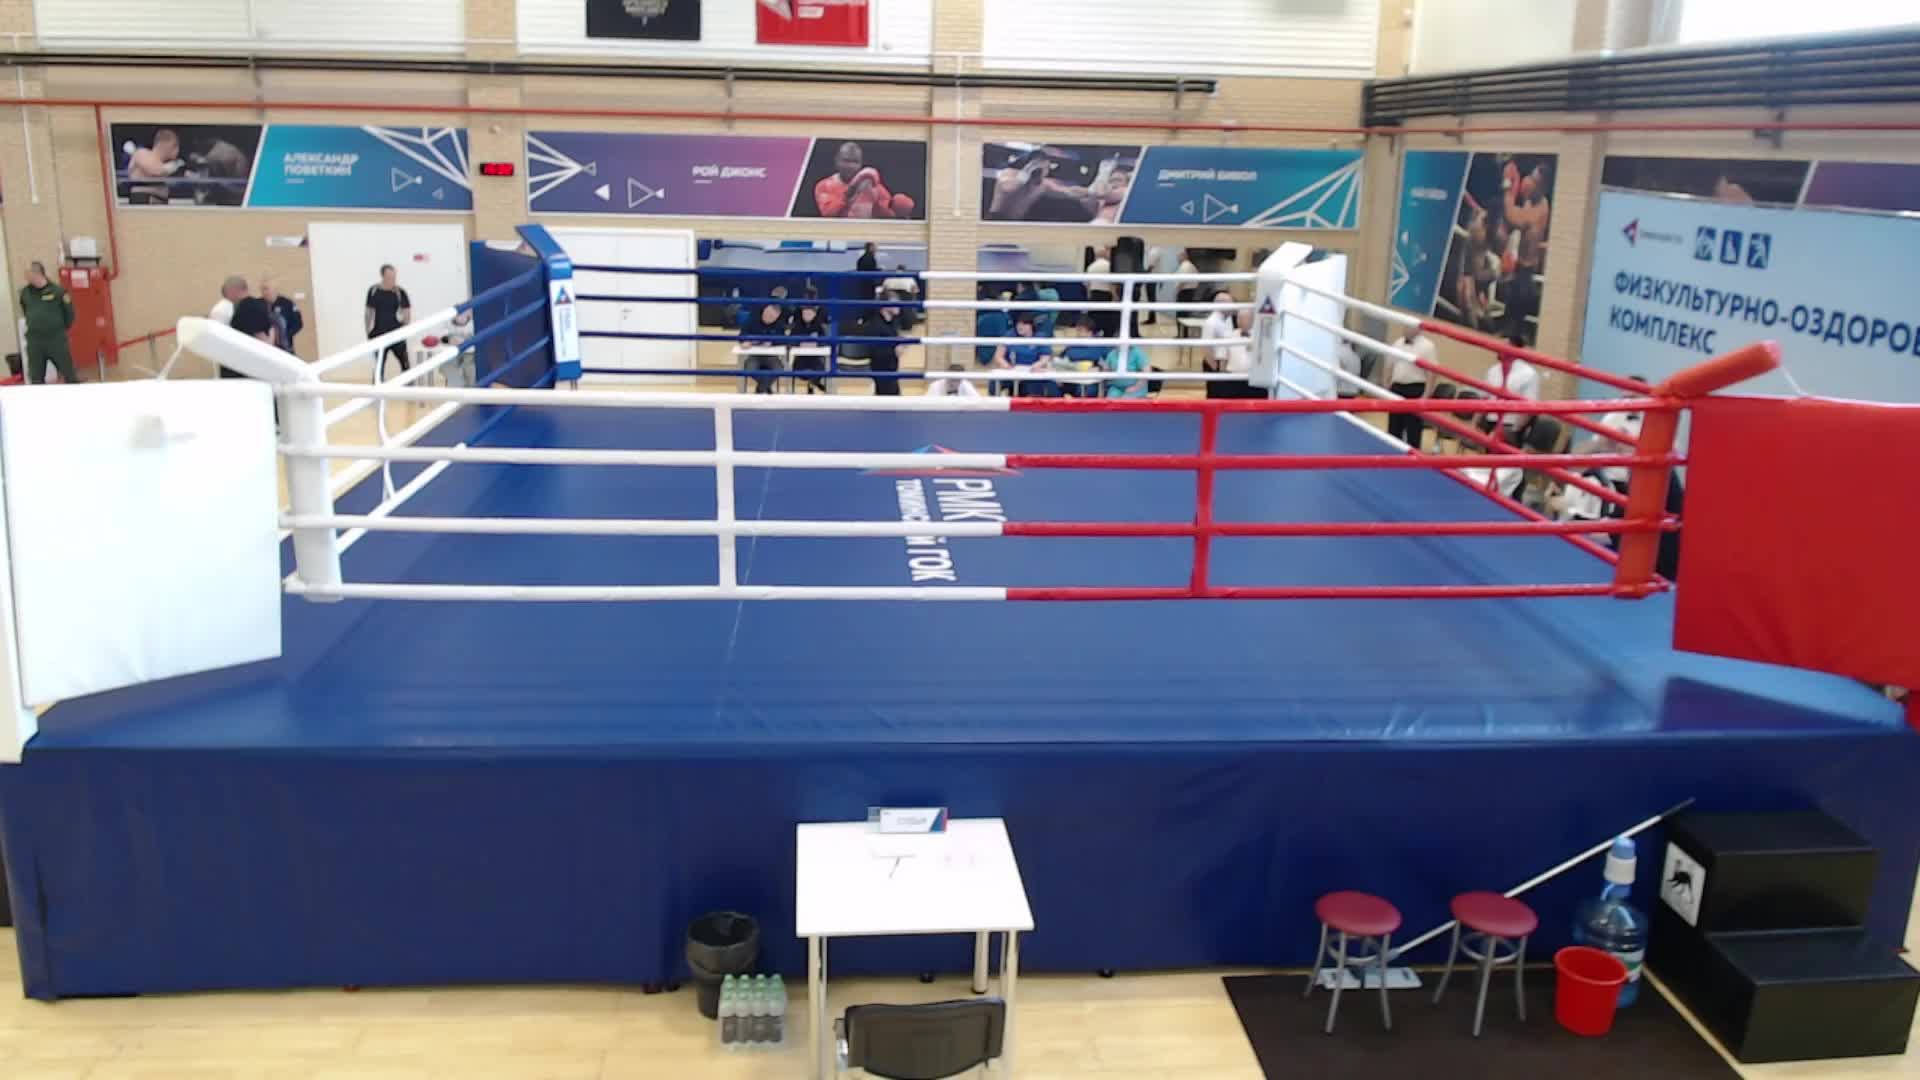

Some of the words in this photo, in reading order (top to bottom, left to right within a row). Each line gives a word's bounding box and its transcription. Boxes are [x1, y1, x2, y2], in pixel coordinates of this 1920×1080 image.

[283, 152, 359, 164] АЛЕКСАНДР
[283, 165, 352, 177] ПОВЕТКИН
[692, 163, 719, 177] РОЙ
[720, 166, 767, 179] ДЖОНС
[1608, 304, 1717, 355] КОМПЛЕКС
[932, 478, 1008, 522] РМК
[906, 548, 957, 581] ГОК
